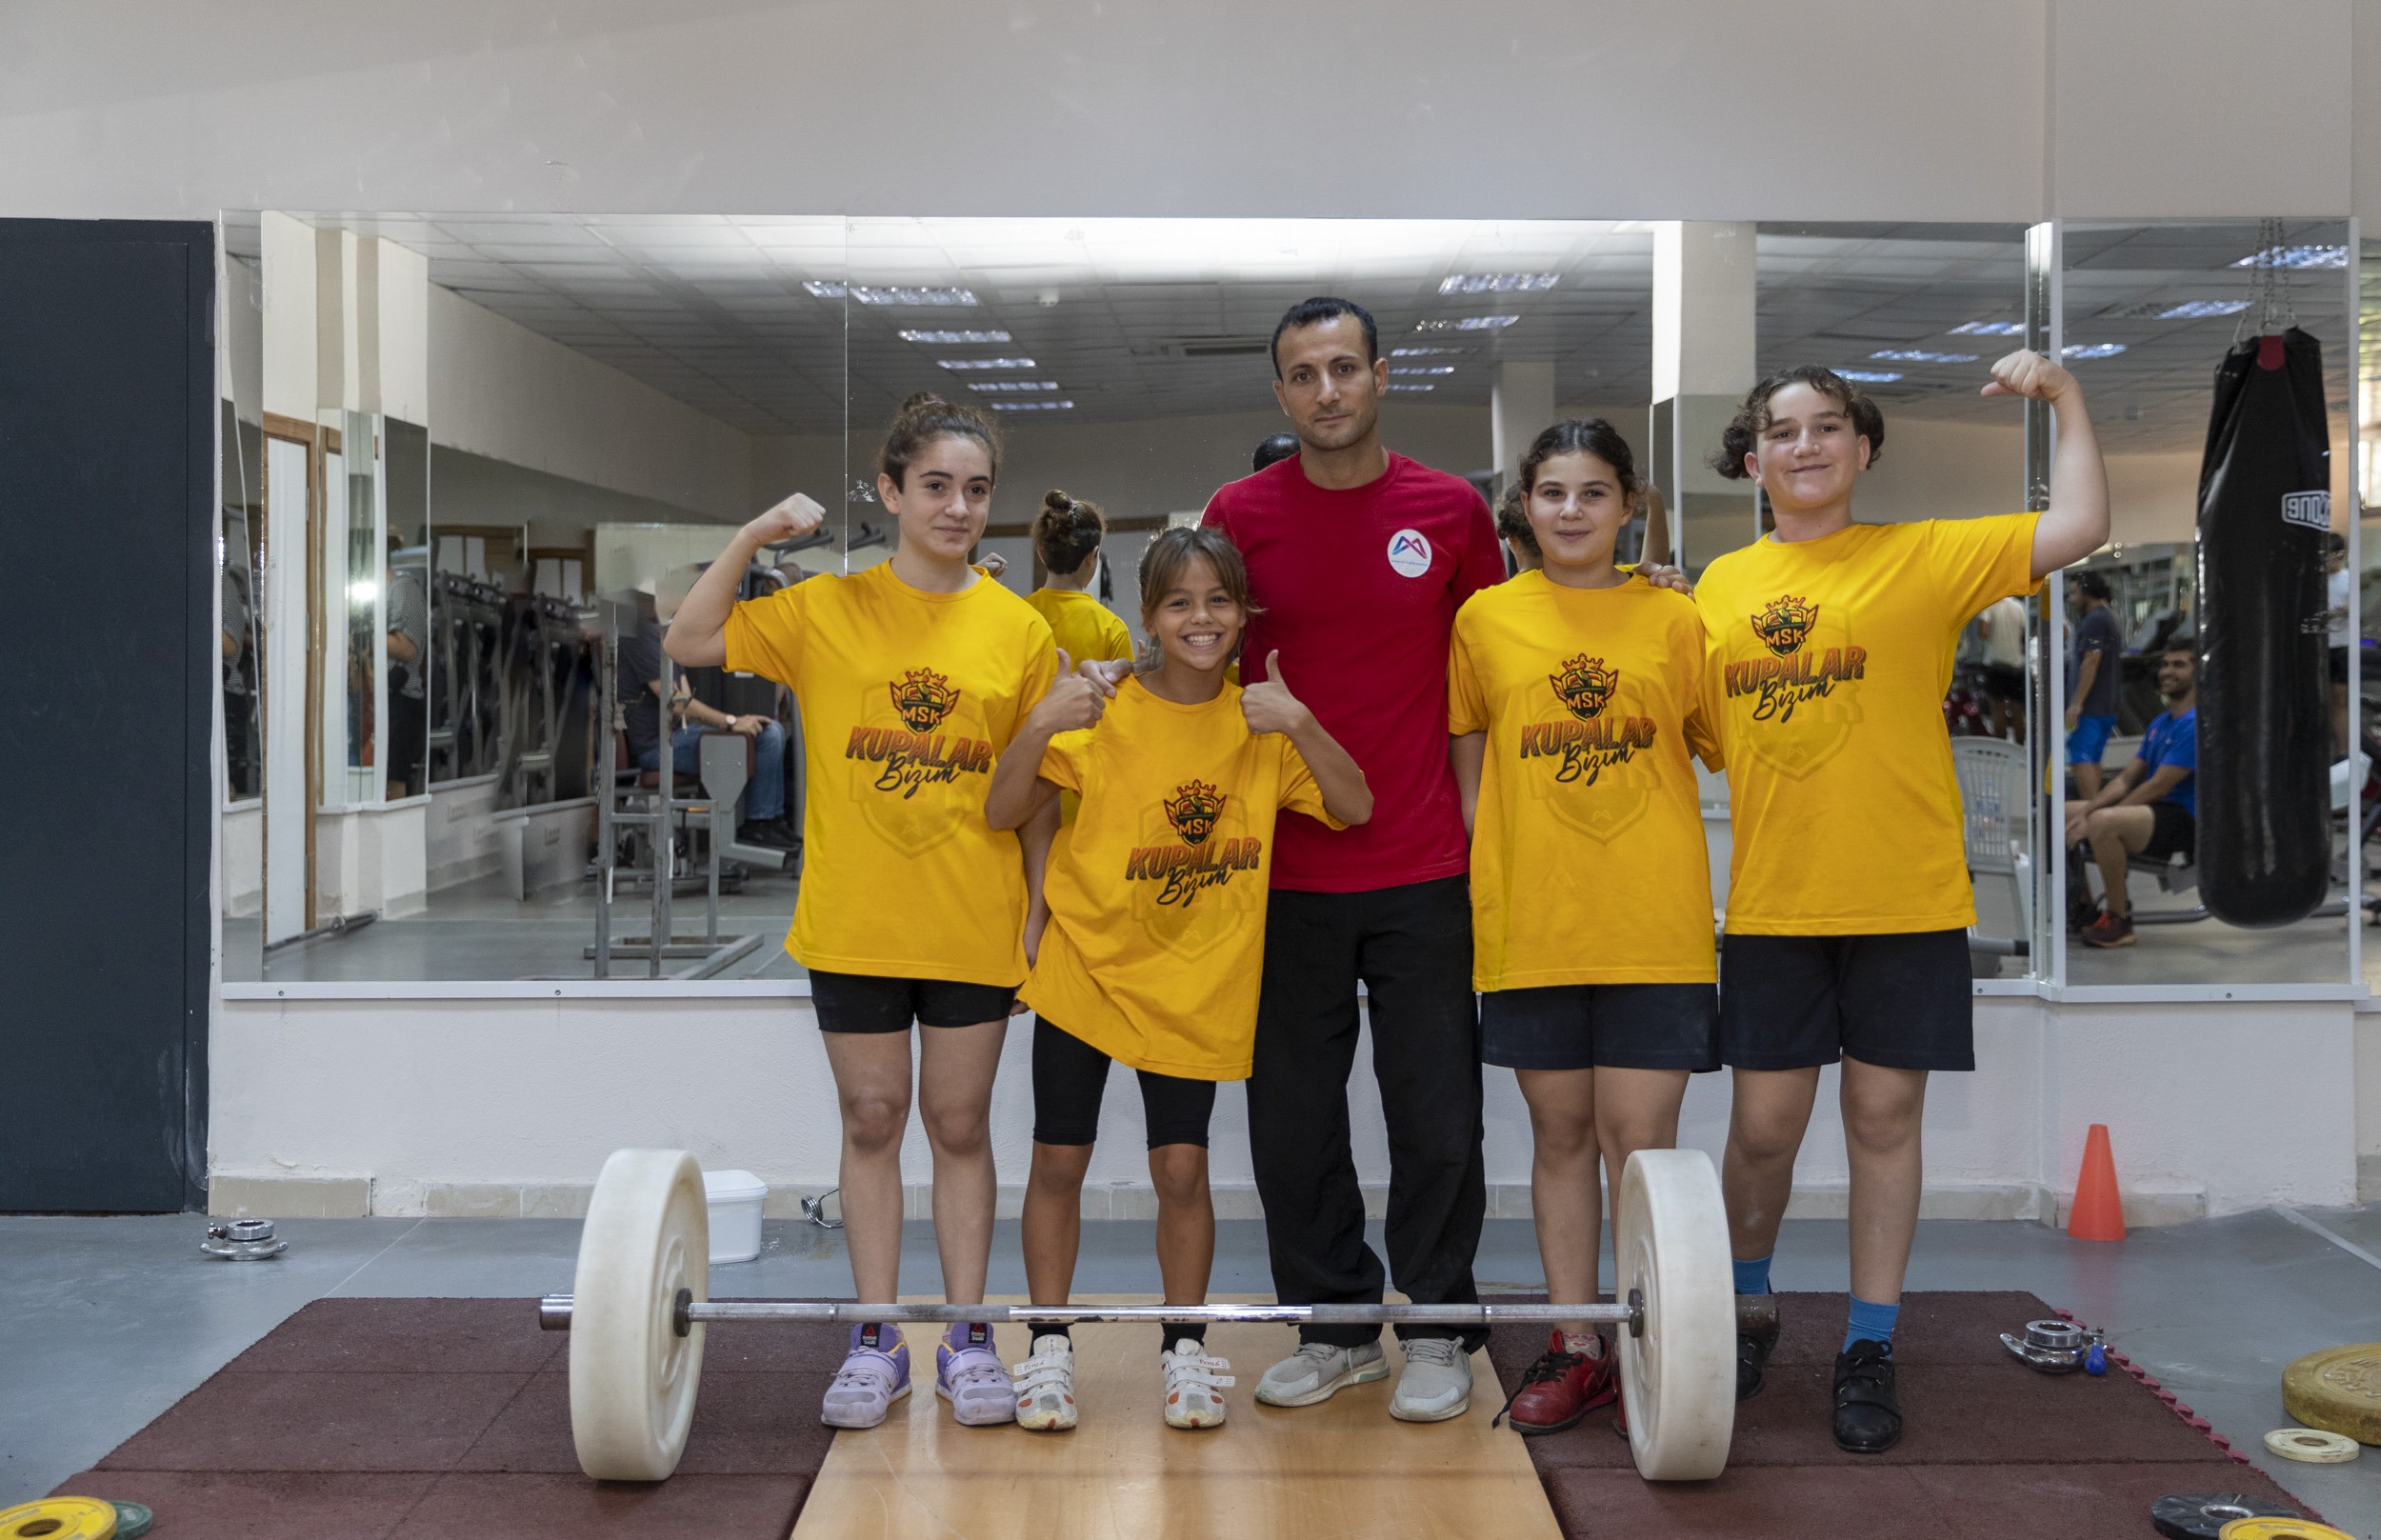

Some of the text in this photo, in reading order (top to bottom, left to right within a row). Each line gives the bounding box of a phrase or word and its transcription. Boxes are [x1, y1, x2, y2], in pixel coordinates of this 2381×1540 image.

[1766, 628, 1807, 648] MSK
[1724, 645, 1867, 698] KUPALAR
[902, 706, 943, 726] MSK
[1567, 691, 1608, 711] MSK
[846, 726, 993, 774] KUPALAR
[1520, 716, 1657, 759] KUPALAR
[1178, 818, 1213, 836] MSK
[1125, 836, 1262, 881] KUPALAR
